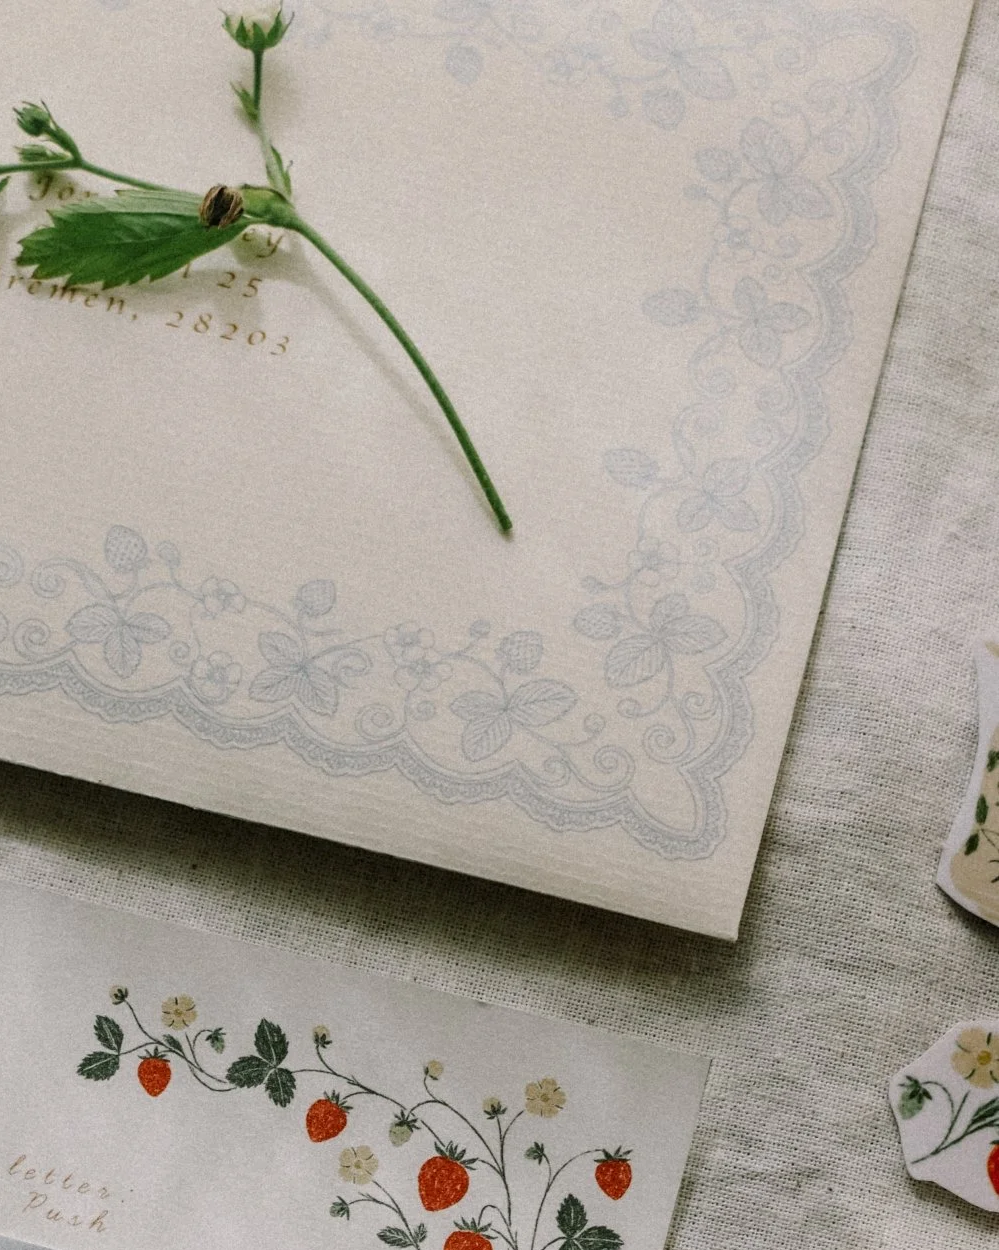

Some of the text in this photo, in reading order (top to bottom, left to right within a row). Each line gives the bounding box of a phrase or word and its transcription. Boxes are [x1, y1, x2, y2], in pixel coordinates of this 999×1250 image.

[216, 270, 263, 299] 25
[165, 309, 293, 357] 28203
[22, 1191, 108, 1234] Push
